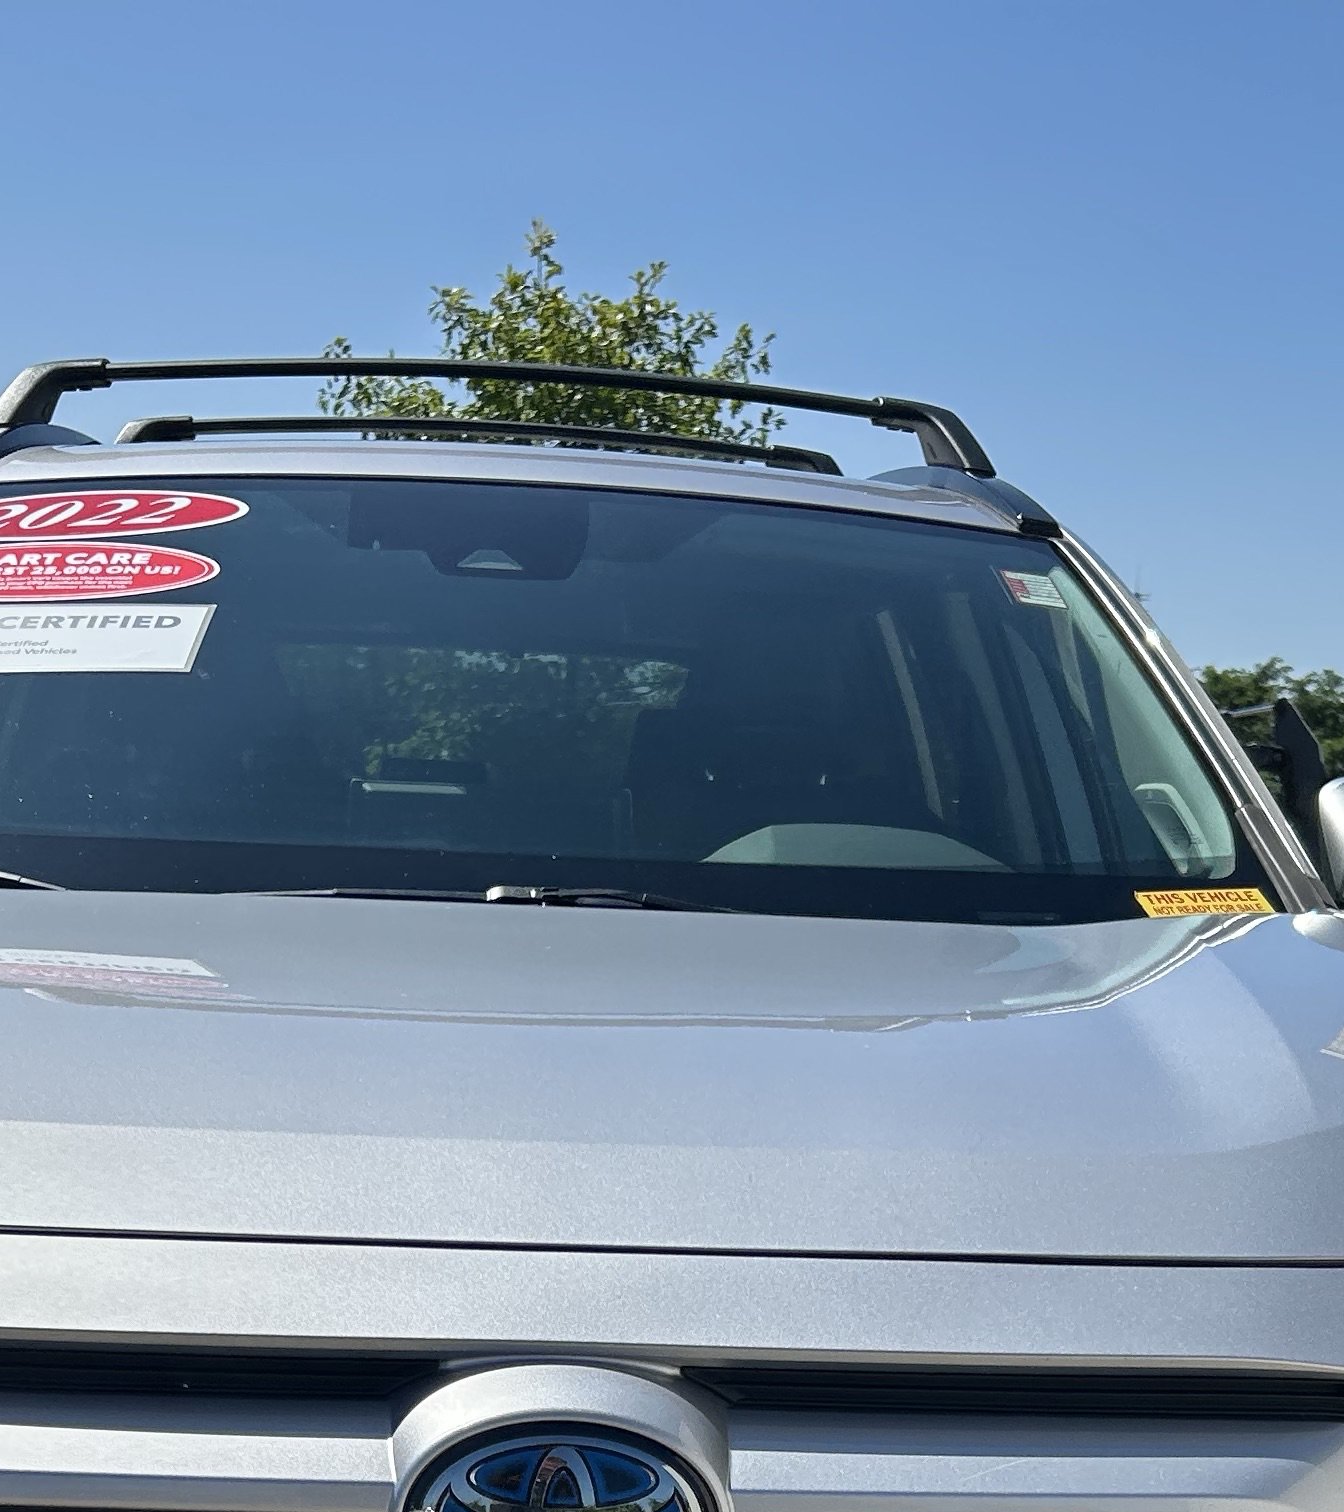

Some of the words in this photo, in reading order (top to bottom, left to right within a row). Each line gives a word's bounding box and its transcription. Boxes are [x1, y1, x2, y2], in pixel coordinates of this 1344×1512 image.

[65, 552, 152, 565] CARE
[105, 565, 141, 575] ON
[144, 565, 182, 575] US!
[24, 647, 77, 655] Vehicles
[1142, 893, 1186, 905] THIS
[1185, 891, 1259, 904] VEHICLE
[1153, 905, 1177, 915] NOT
[1176, 904, 1214, 914] READY
[1214, 904, 1236, 913] FOR
[1236, 903, 1266, 912] SALE
